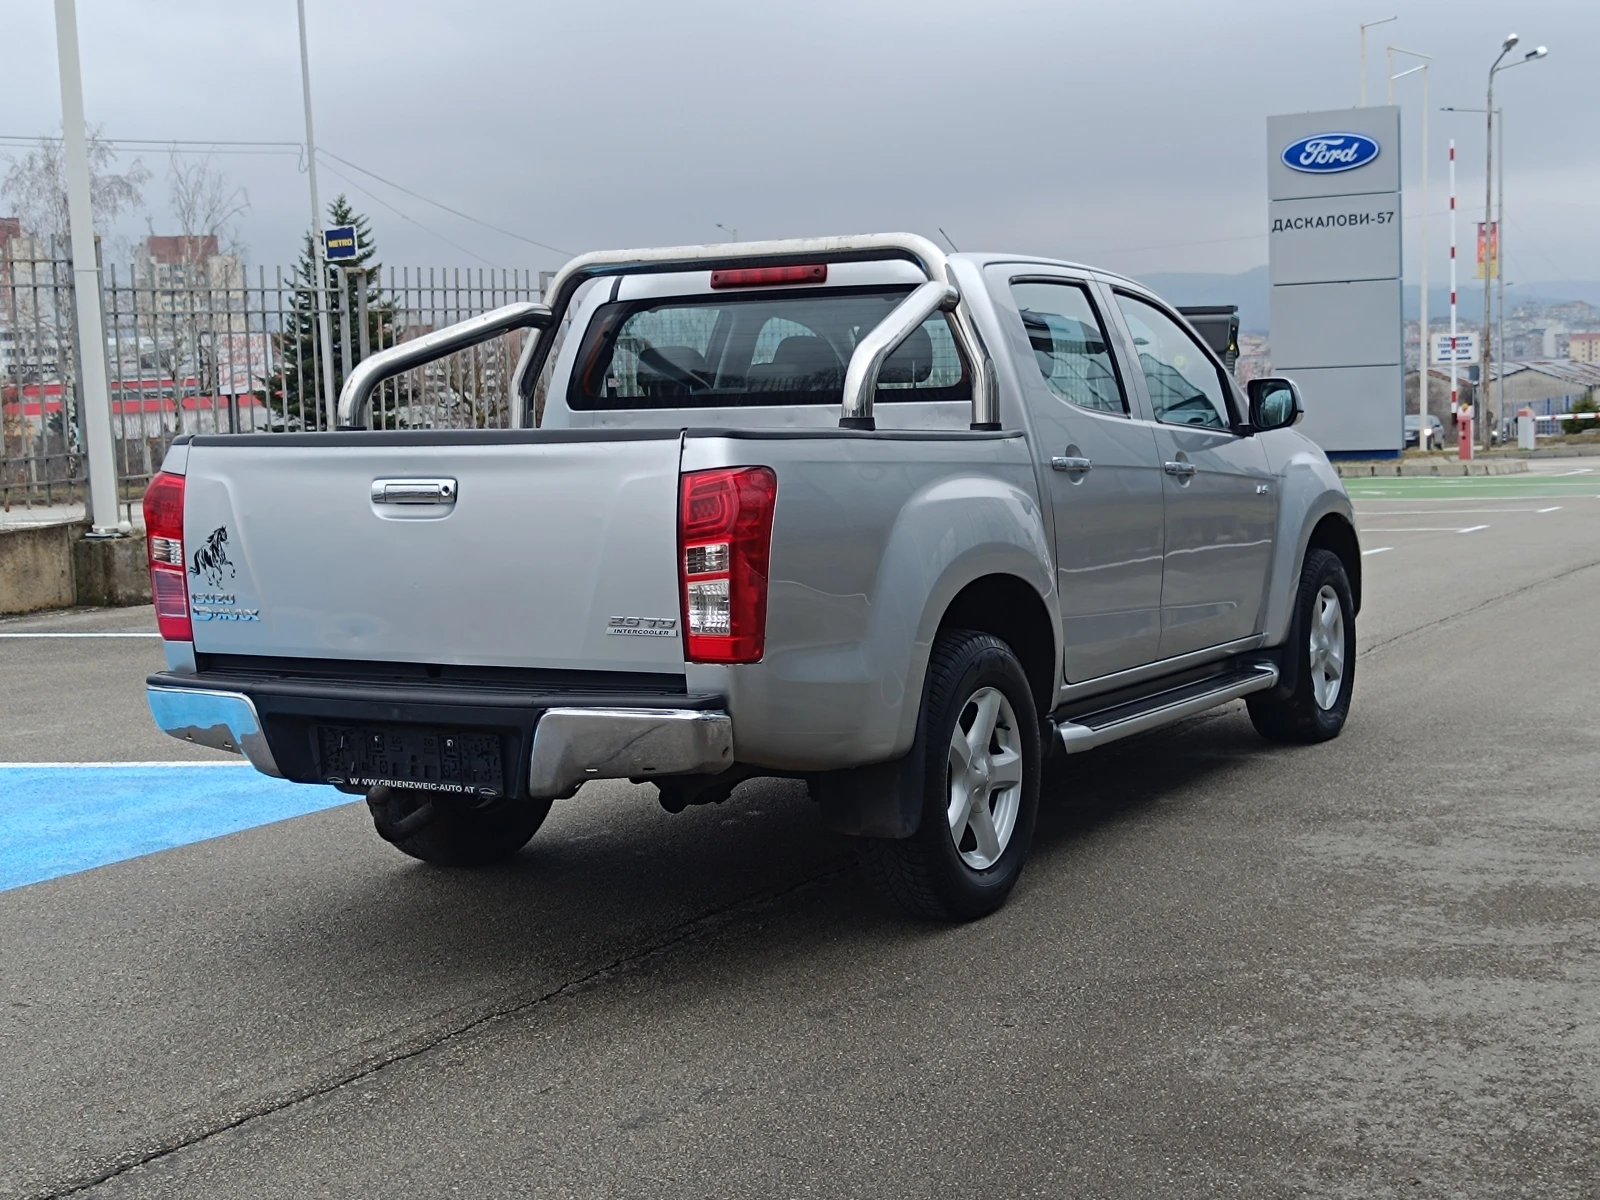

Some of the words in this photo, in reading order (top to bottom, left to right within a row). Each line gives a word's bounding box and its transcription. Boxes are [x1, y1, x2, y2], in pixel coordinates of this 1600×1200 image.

[1299, 138, 1360, 165] Ford
[1271, 211, 1395, 233] ДАСКАЛОВИ-57
[328, 238, 353, 248] METRO
[191, 593, 236, 605] ISUZU
[193, 605, 260, 621] D-MAX
[613, 628, 670, 636] INTERCOOLER
[349, 778, 475, 793] WWW.GRUENZWEIG-AUTOAT
